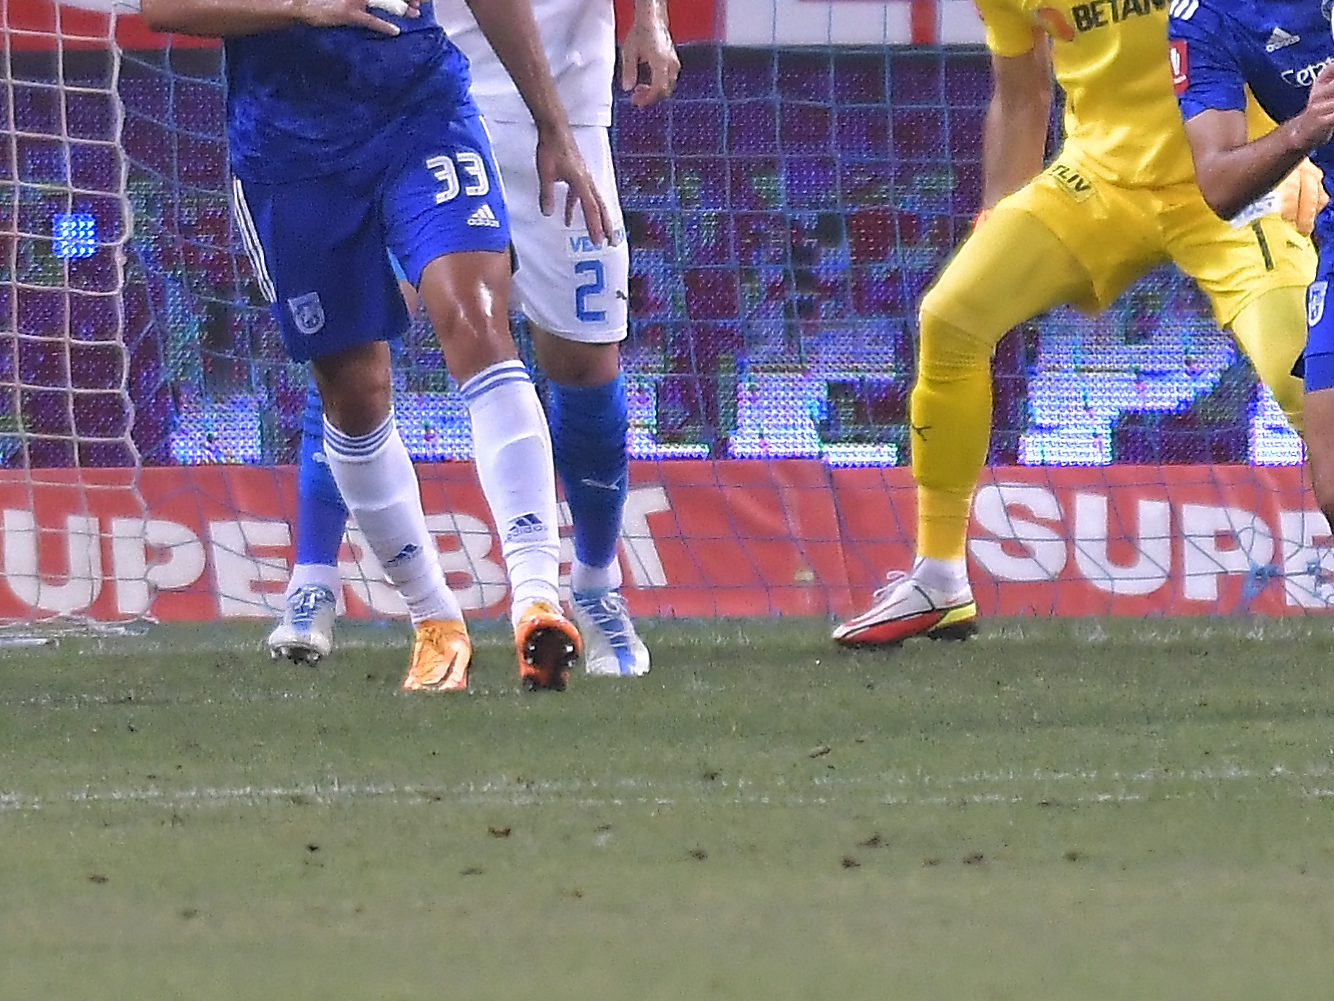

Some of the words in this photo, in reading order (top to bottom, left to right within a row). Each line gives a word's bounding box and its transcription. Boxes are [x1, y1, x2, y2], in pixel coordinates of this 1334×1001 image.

[426, 152, 490, 205] 33
[574, 259, 607, 324] 2
[2, 487, 671, 621] UPEBT
